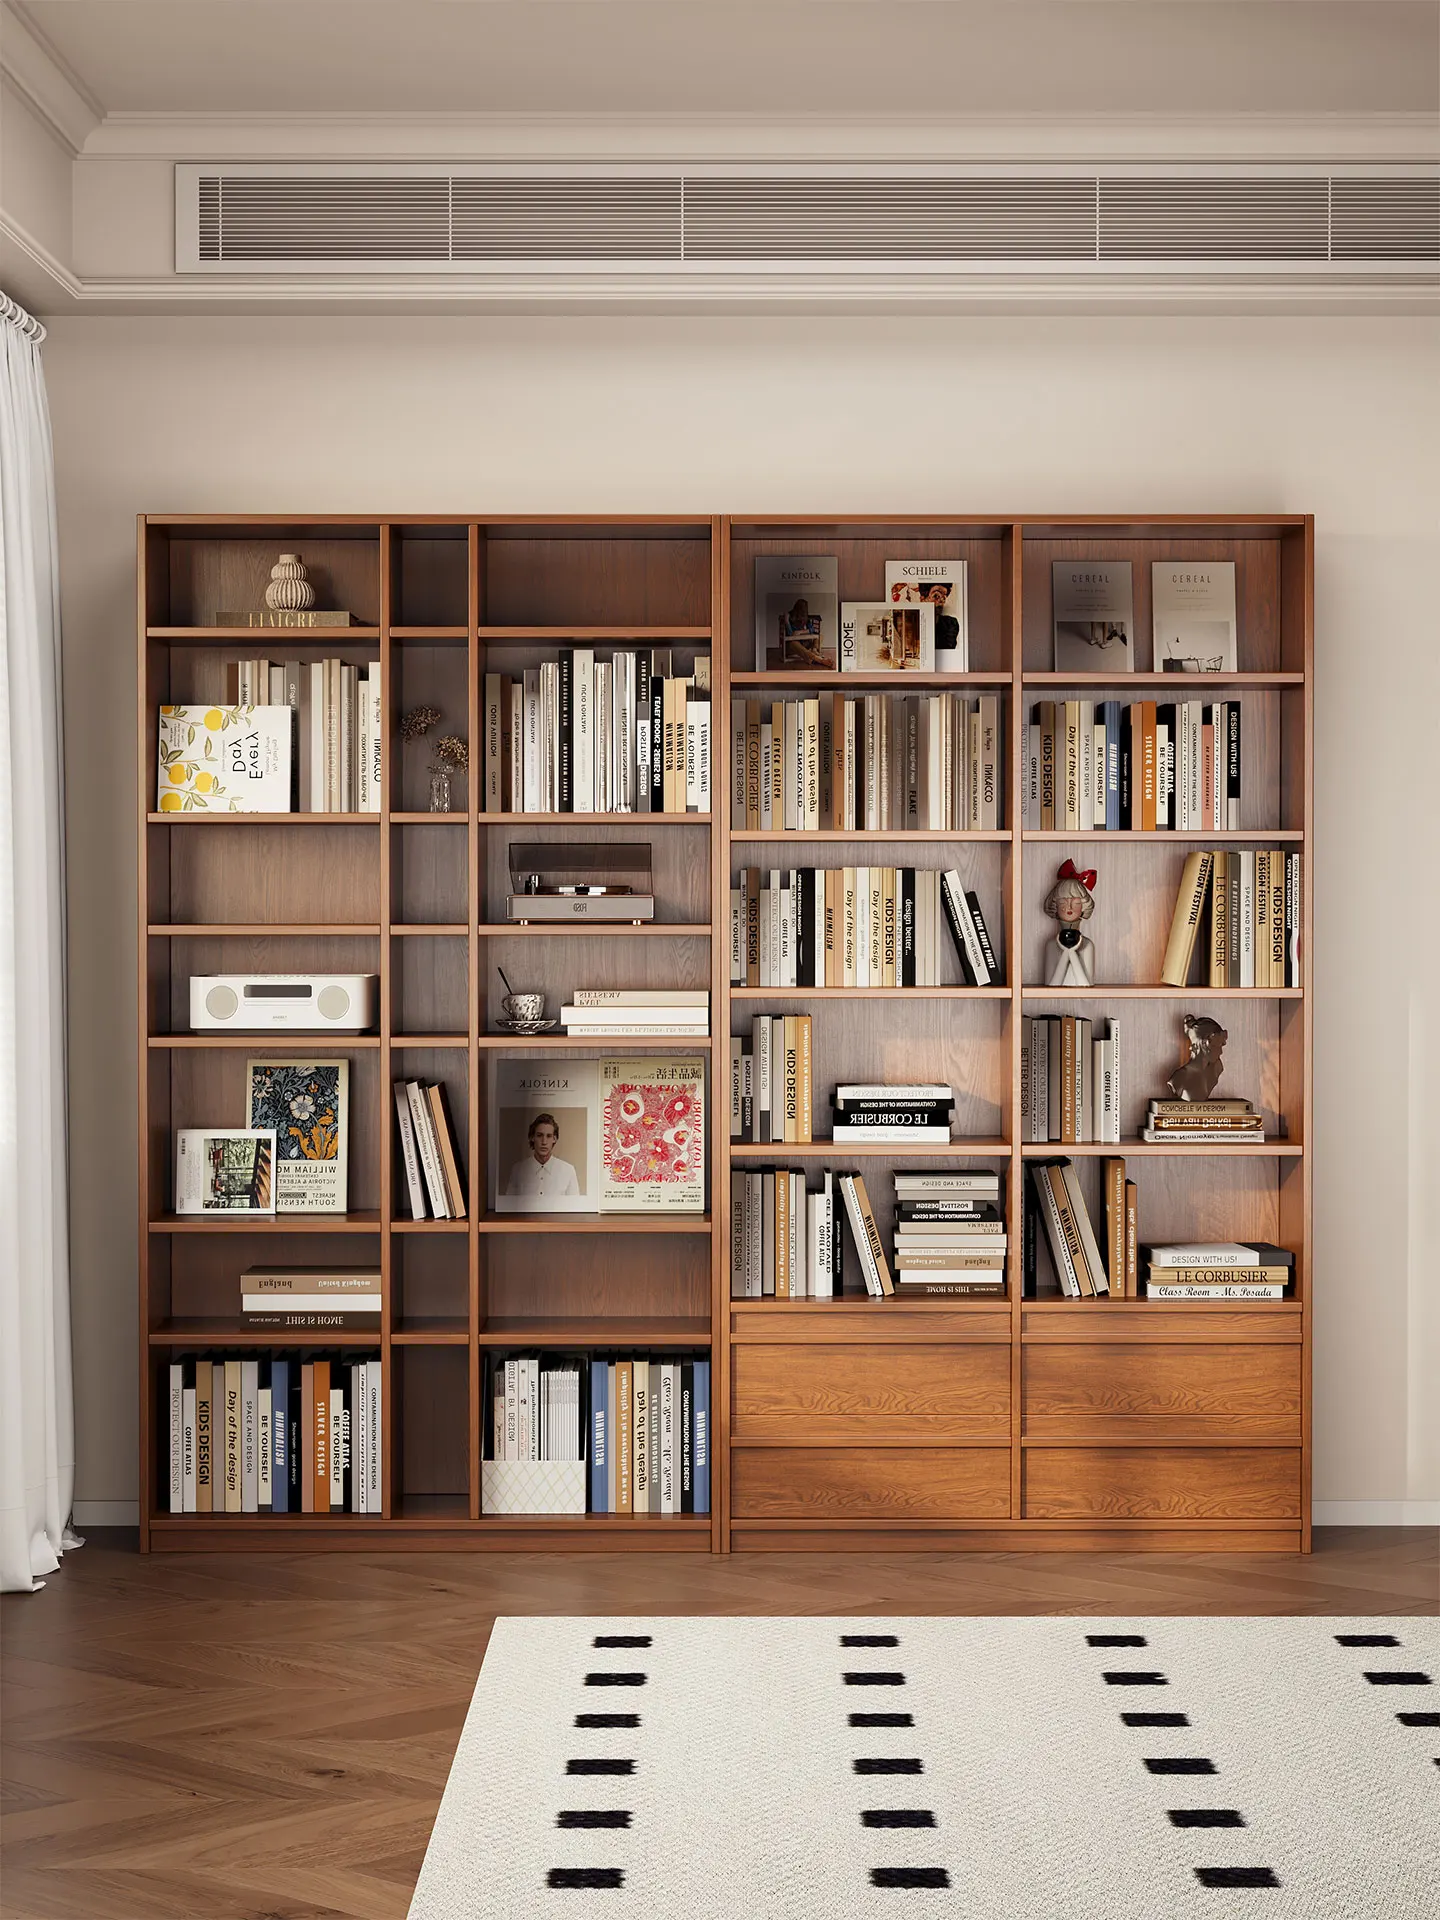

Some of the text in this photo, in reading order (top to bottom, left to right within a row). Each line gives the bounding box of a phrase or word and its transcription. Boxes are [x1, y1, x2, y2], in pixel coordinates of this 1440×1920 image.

[781, 572, 821, 580] KINFOLK
[902, 566, 948, 576] SCHIELE
[1071, 574, 1110, 583] CEREAL
[1172, 574, 1211, 583] CEREAL
[249, 613, 317, 628] LIAIGRE
[843, 621, 854, 657] HOME
[1043, 734, 1053, 808] KIDS DESIGN
[1067, 725, 1077, 813] Day of the design
[1097, 746, 1103, 759] BE
[1109, 743, 1117, 791] MINIMALISM
[1145, 735, 1153, 800] SILVER DESIGN
[1159, 746, 1166, 759] BE
[984, 764, 993, 803] ПИКАССО
[1188, 858, 1209, 926] DESIGN FESTIVAL
[1258, 857, 1266, 926] DESIGN FESTIVAL
[732, 909, 740, 964] BE YOURSELF
[748, 898, 757, 965] KIDS DESIGN
[844, 890, 854, 970] Day of the design
[871, 890, 880, 970] Day of the design
[885, 898, 894, 965] KIDS DESIGN
[1216, 876, 1226, 967] LE CORBUSIER
[1273, 886, 1283, 963] KIDS DESIGN
[734, 1201, 742, 1271] BETTER DESIGN
[1171, 1255, 1238, 1264] DESIGN WITH US!
[1176, 1270, 1269, 1283] LE CORBUSIER
[199, 1400, 209, 1485] KIDS DESIGN
[226, 1390, 237, 1491] Day of the design
[261, 1415, 268, 1429] BE
[275, 1411, 285, 1466] MINIMALISM
[317, 1402, 325, 1477] SILVER DESIGN
[333, 1415, 340, 1429] BE
[371, 1442, 377, 1452] OF
